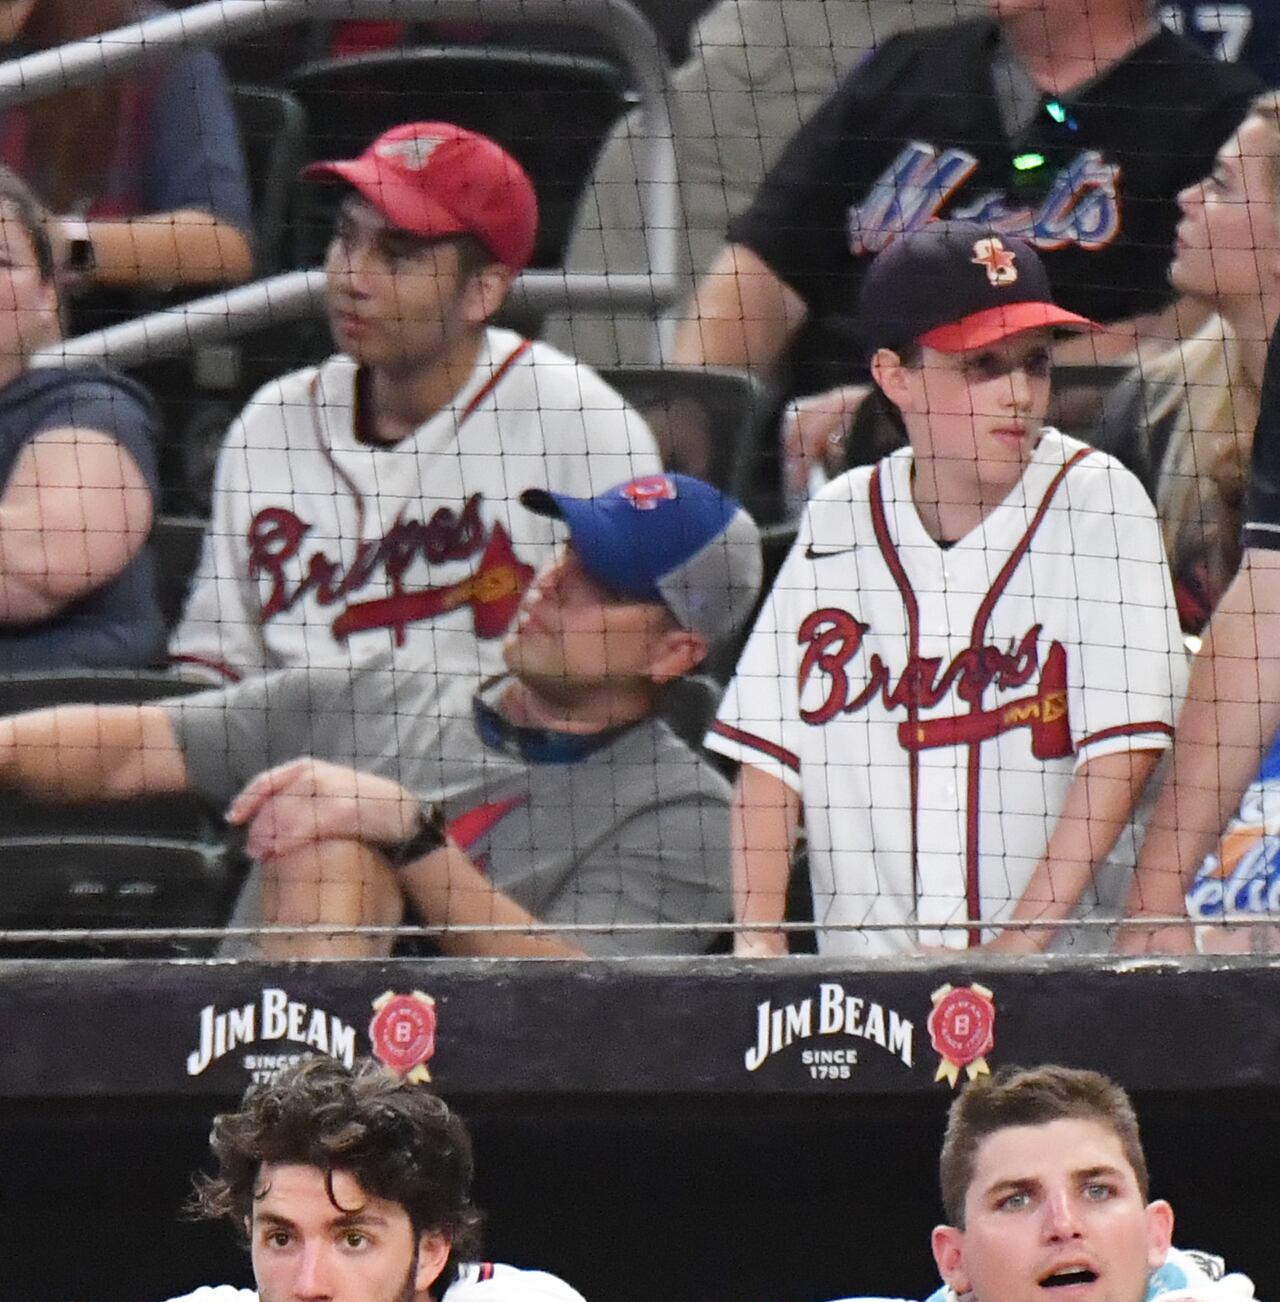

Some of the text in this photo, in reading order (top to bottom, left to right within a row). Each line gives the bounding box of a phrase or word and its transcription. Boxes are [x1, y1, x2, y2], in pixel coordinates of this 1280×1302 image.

[186, 1004, 256, 1076] JIM
[261, 988, 357, 1071] BEAM
[396, 1021, 411, 1042] B
[744, 999, 813, 1072] JIM
[818, 983, 914, 1069] BEAM
[954, 1014, 969, 1035] B
[801, 1049, 858, 1065] SINCE
[810, 1065, 851, 1080] 1795
